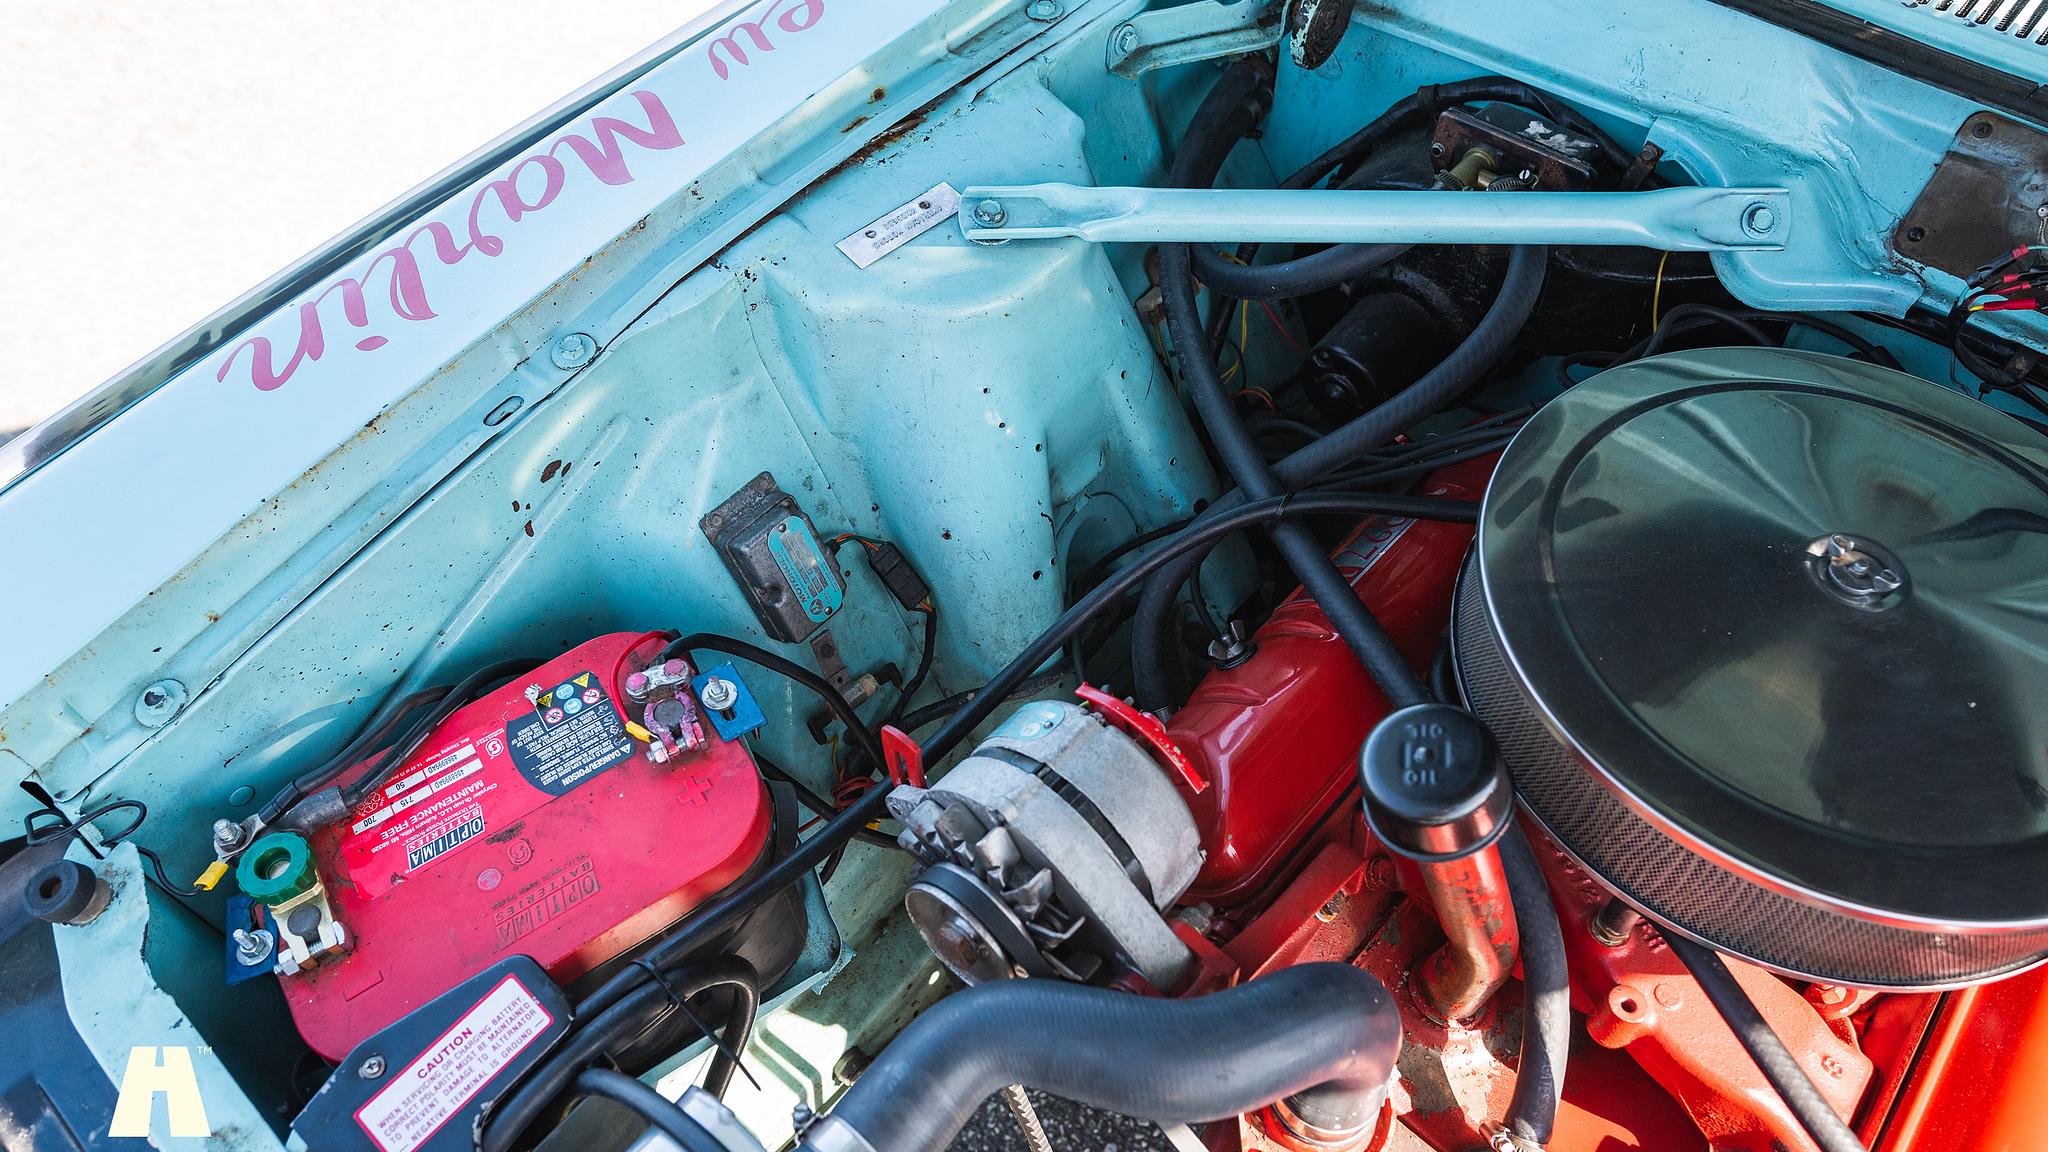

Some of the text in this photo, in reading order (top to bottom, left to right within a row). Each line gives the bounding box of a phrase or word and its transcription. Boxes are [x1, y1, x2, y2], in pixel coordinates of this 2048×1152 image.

[216, 91, 685, 392] Marlin
[774, 551, 807, 603] MOTOROLA
[394, 781, 405, 790] 50
[560, 749, 621, 785] DANGER/POISON
[362, 815, 376, 826] 700
[399, 795, 414, 806] 715
[409, 779, 484, 823] MAINTENANCE
[379, 819, 409, 839] FREE
[408, 808, 479, 851] BATTERIES
[410, 818, 481, 865] OPTIMA
[495, 860, 591, 922] BATTERIES
[498, 873, 597, 944] OPTIMA
[377, 1106, 401, 1129] WHEN
[401, 1070, 441, 1107] SERVICING
[441, 1058, 454, 1070] OR
[453, 1024, 491, 1059] CHARGING
[383, 1001, 530, 1137] CORRECT POLARITY MUST BE MAINTAINED
[390, 1008, 536, 1144] TO PREVENT DAMAGE TO ALTERNATOR
[416, 1026, 473, 1079] CAUTION
[410, 1027, 533, 1141] NEGATIVE TERMINAL IS GROUND
